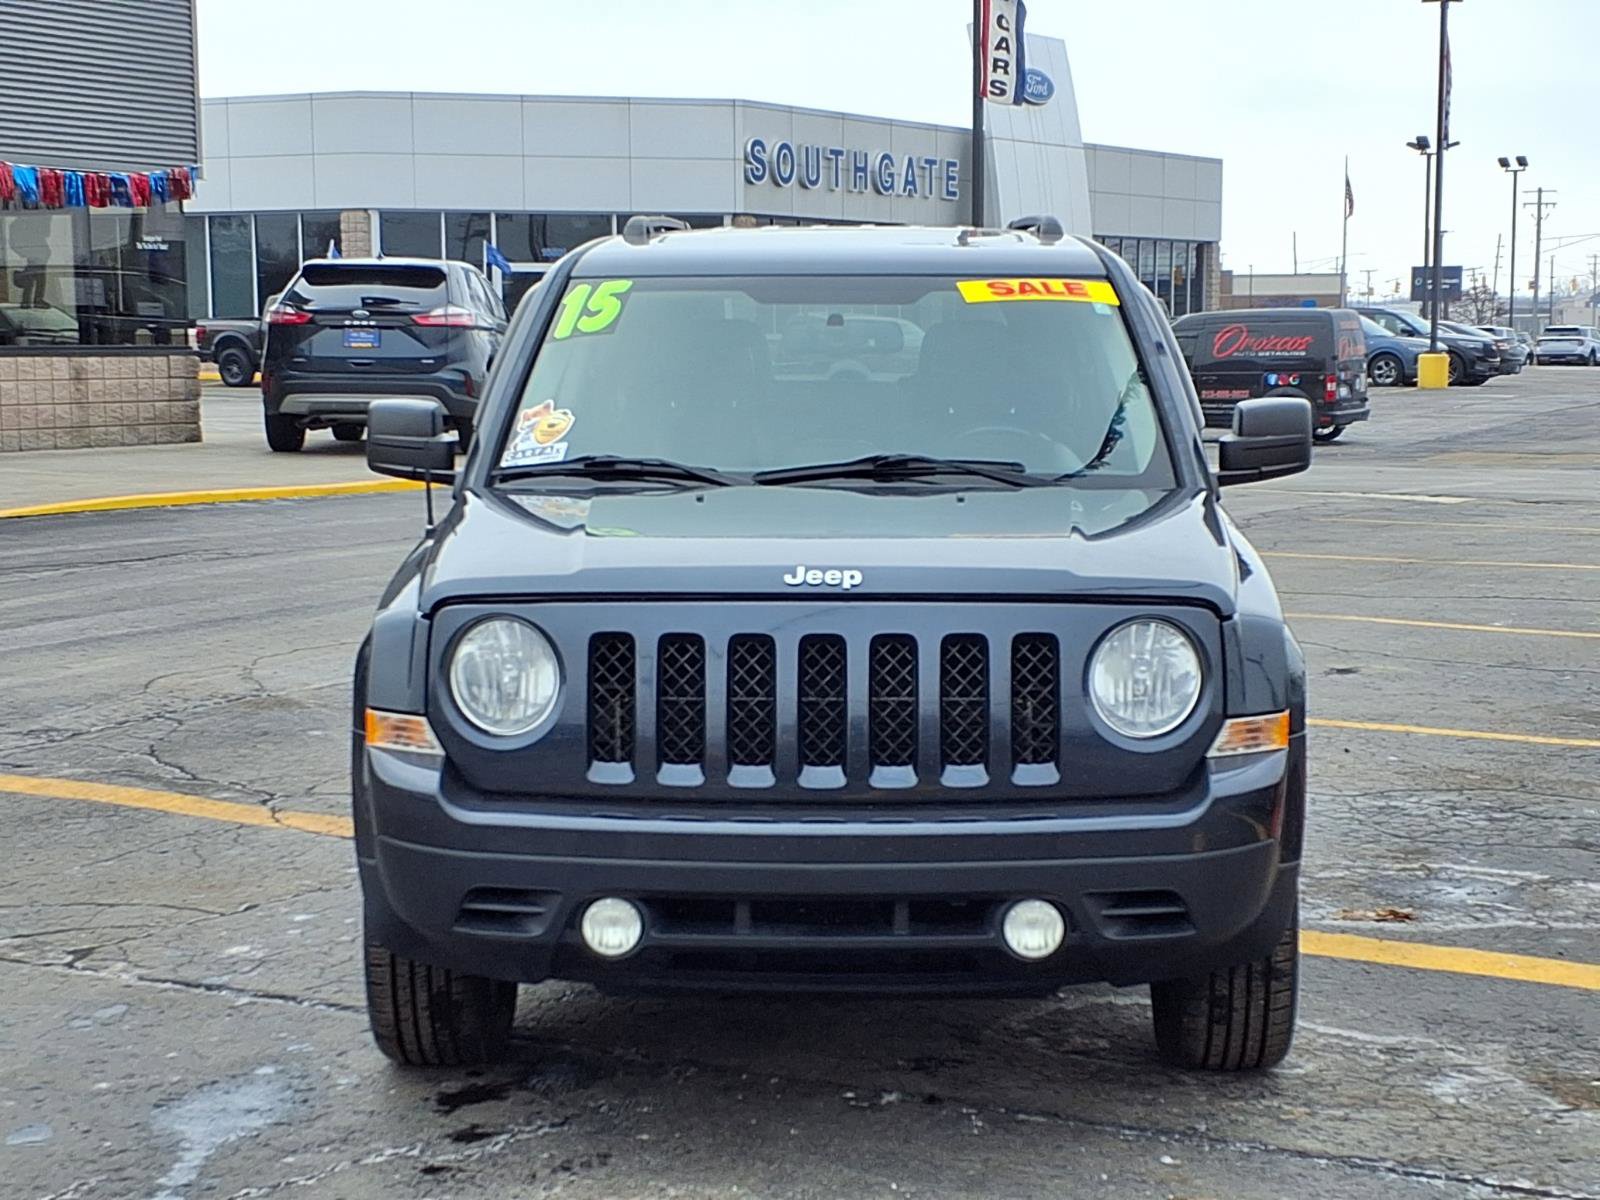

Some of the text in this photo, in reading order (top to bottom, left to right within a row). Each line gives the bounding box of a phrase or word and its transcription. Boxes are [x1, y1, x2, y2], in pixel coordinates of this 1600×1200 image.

[989, 13, 1010, 97] CARS
[1026, 73, 1049, 96] Ford
[745, 137, 960, 200] SOUTHGATE
[553, 279, 633, 340] 15
[986, 281, 1090, 298] SALE
[783, 565, 863, 590] Jeep
